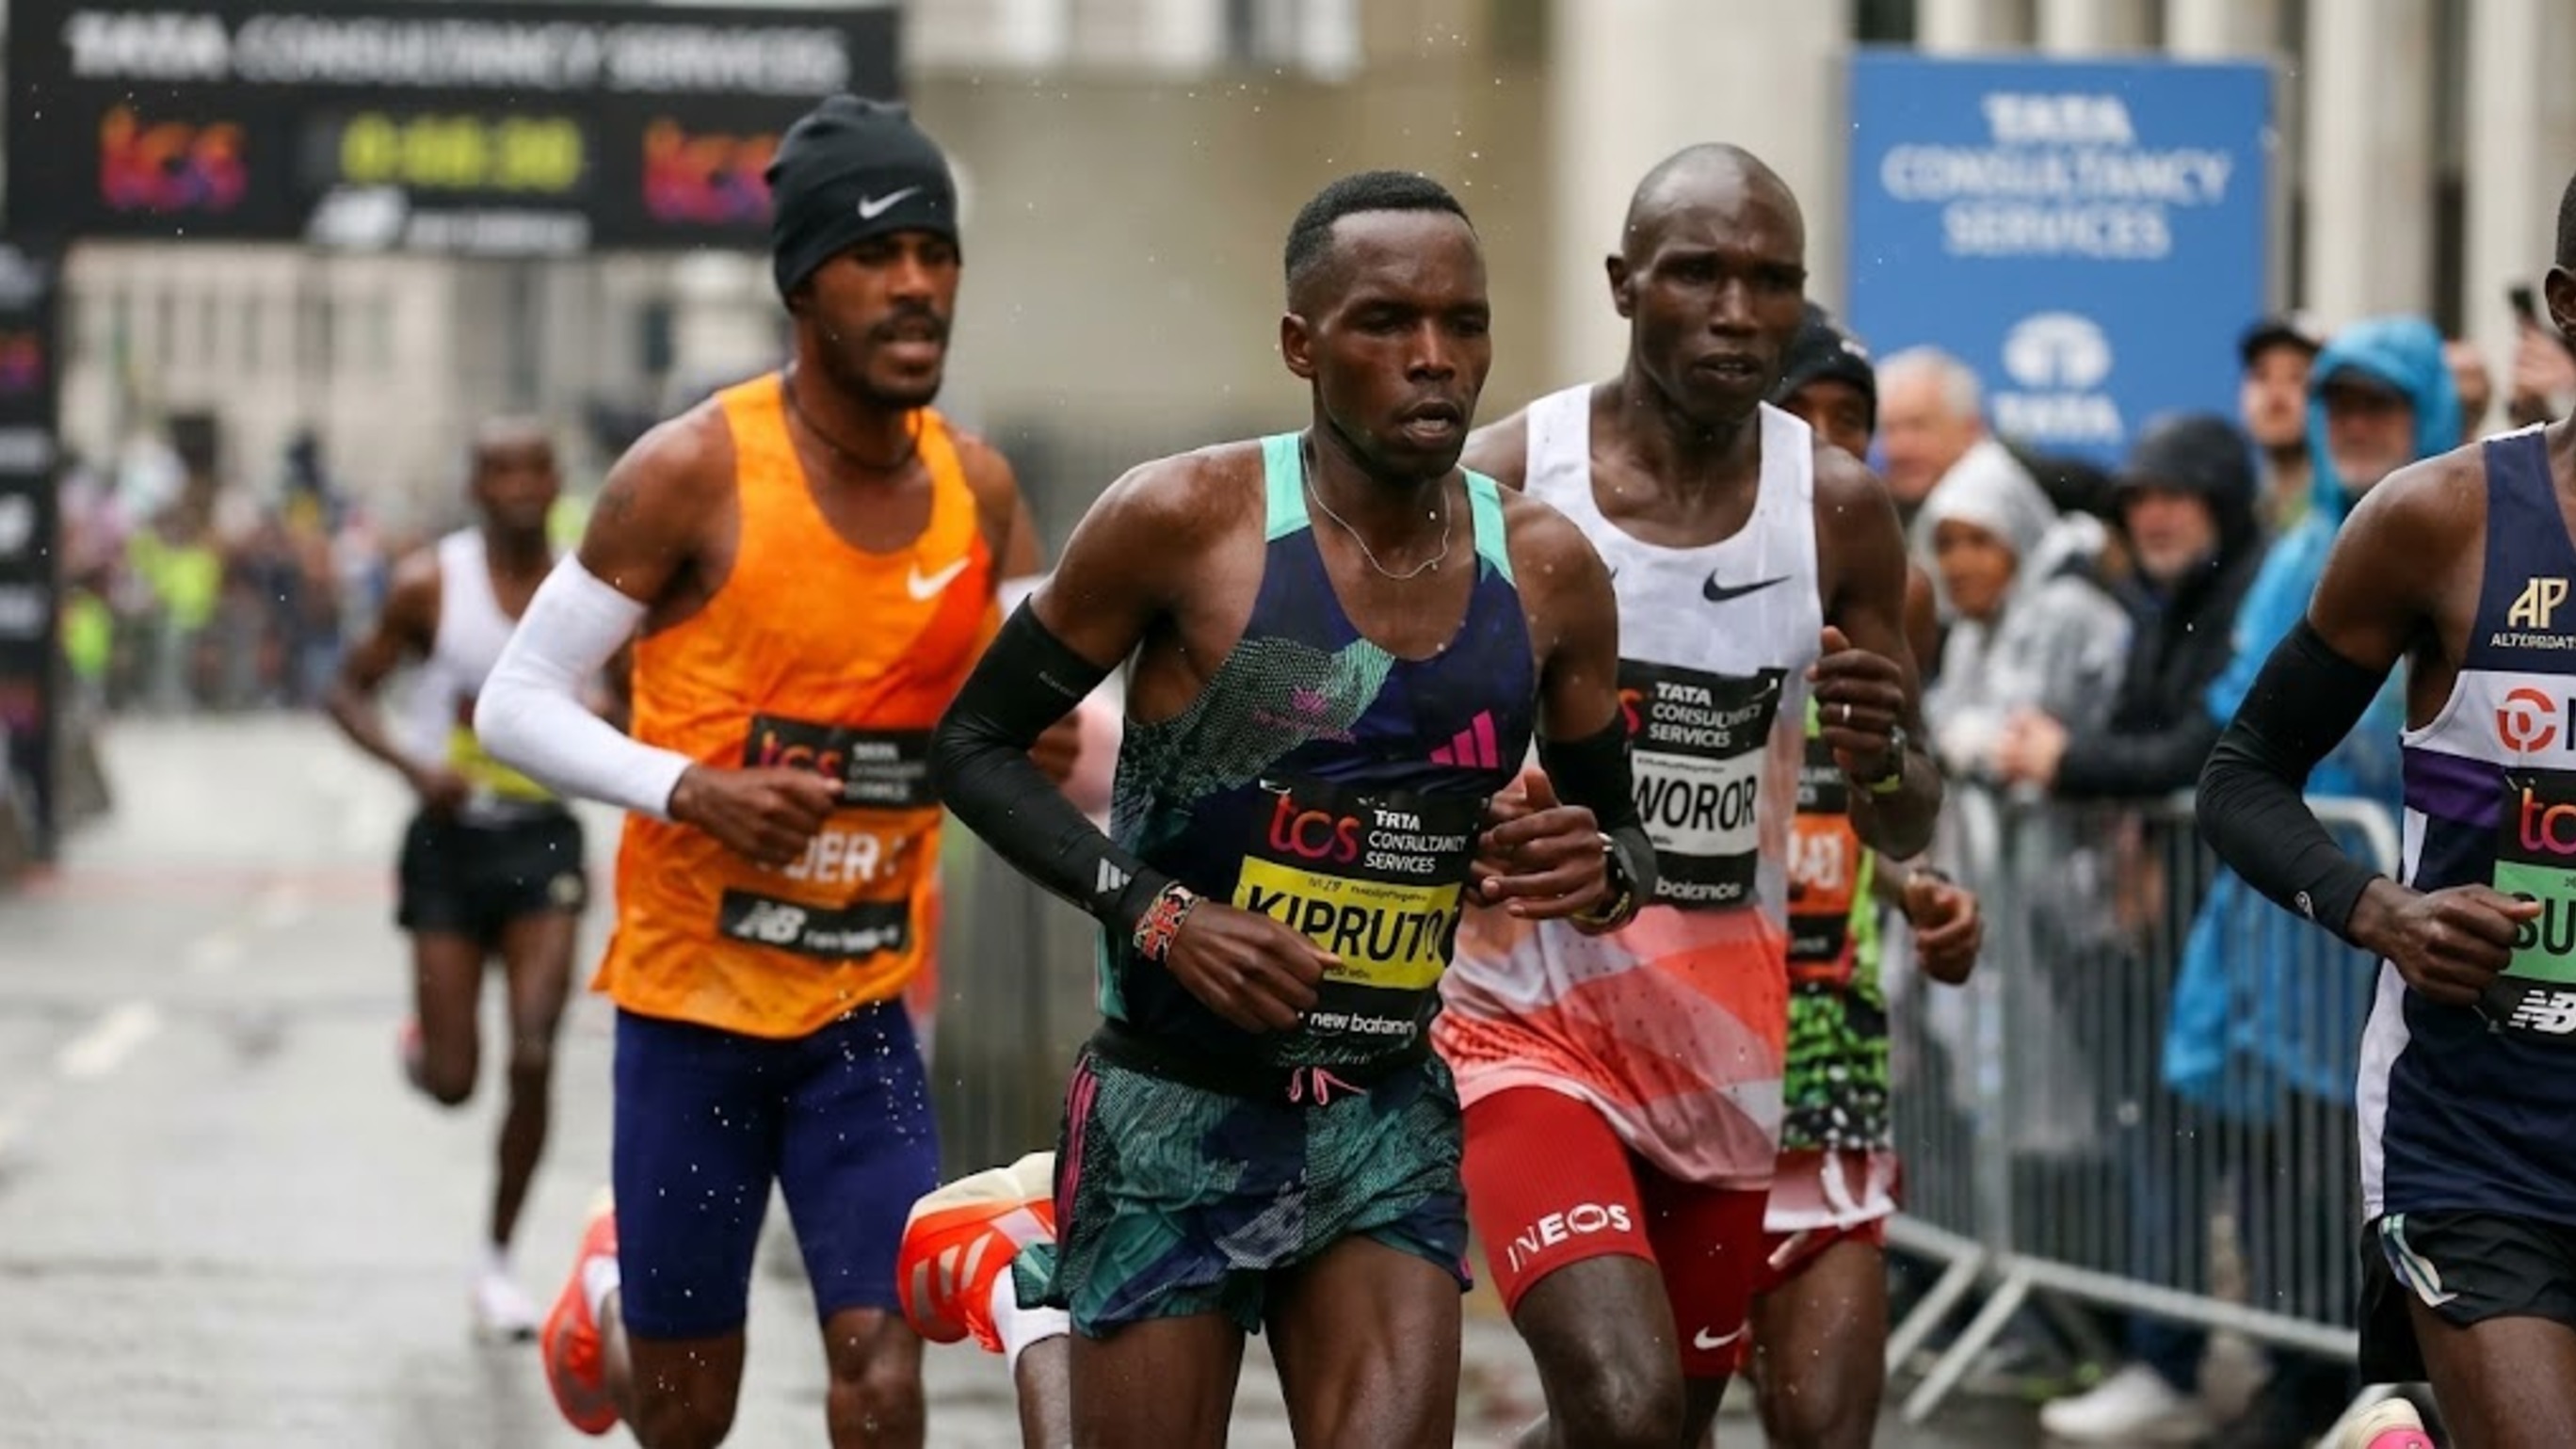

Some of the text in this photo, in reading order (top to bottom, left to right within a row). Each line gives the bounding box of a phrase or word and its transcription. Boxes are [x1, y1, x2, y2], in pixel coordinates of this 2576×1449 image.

[1983, 92, 2133, 145] TATA
[1882, 145, 2230, 205] CONSULTANCY
[1942, 199, 2171, 259] SERVICES
[1993, 391, 2122, 443] TATA
[2508, 577, 2569, 629] AP
[1655, 681, 1712, 707] TATA
[1648, 721, 1731, 749] SERVICES
[1270, 793, 1360, 862] tcs
[1364, 850, 1436, 874] SERVICES
[1310, 1012, 1349, 1030] new
[1507, 1203, 1633, 1273] INEOS
